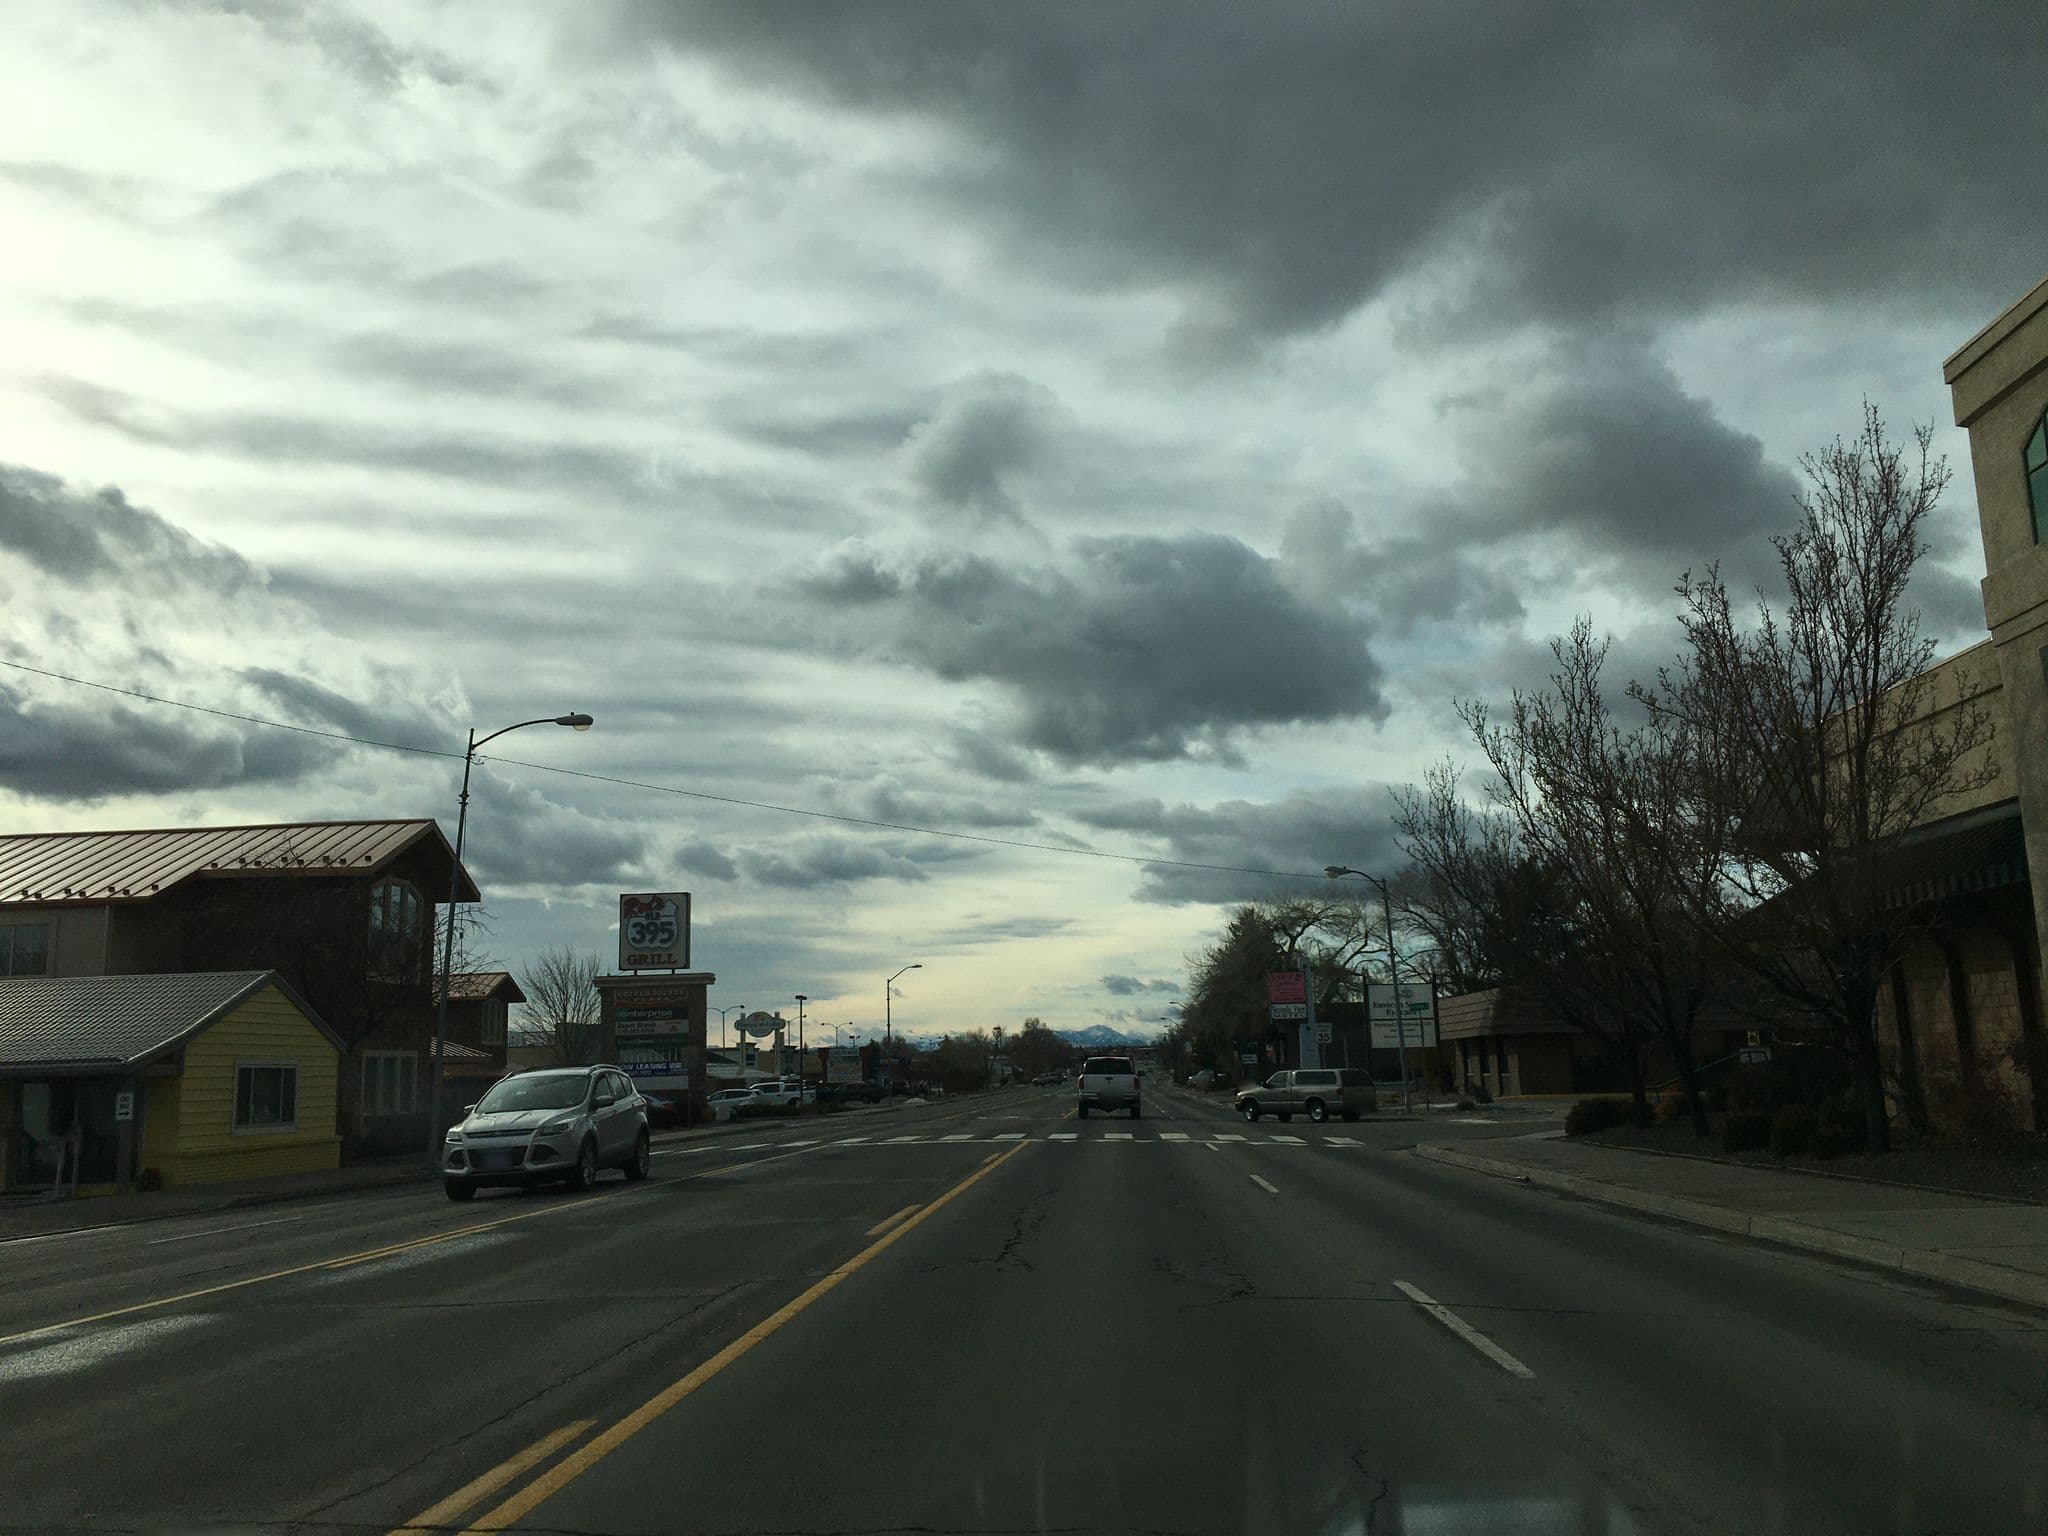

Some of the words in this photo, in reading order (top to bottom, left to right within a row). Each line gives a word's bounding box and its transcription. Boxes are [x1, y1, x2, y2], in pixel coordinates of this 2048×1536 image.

[631, 922, 675, 944] 395
[627, 954, 678, 966] GRILL
[1317, 1033, 1330, 1042] 35
[636, 1062, 667, 1070] LEASING
